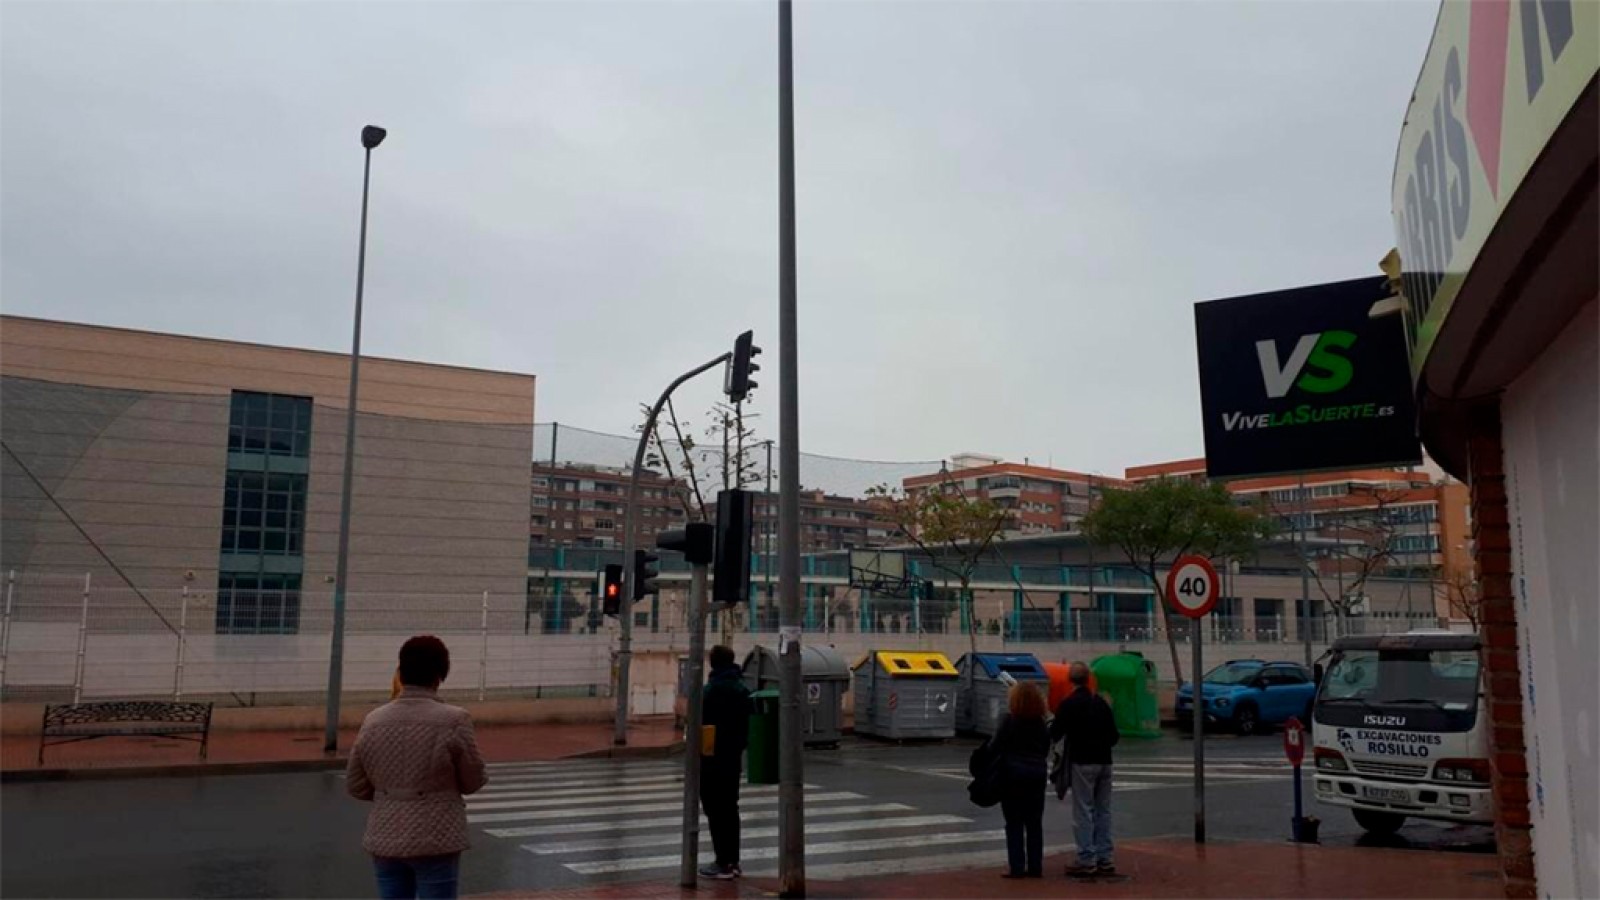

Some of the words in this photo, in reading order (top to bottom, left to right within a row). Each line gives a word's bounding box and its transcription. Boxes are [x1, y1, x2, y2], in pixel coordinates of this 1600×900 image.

[1255, 329, 1357, 399] VS
[1179, 577, 1206, 597] 40
[1363, 715, 1406, 726] ISUZU
[1357, 730, 1442, 745] EXCAVACIONES
[1368, 742, 1429, 757] ROSILLO
